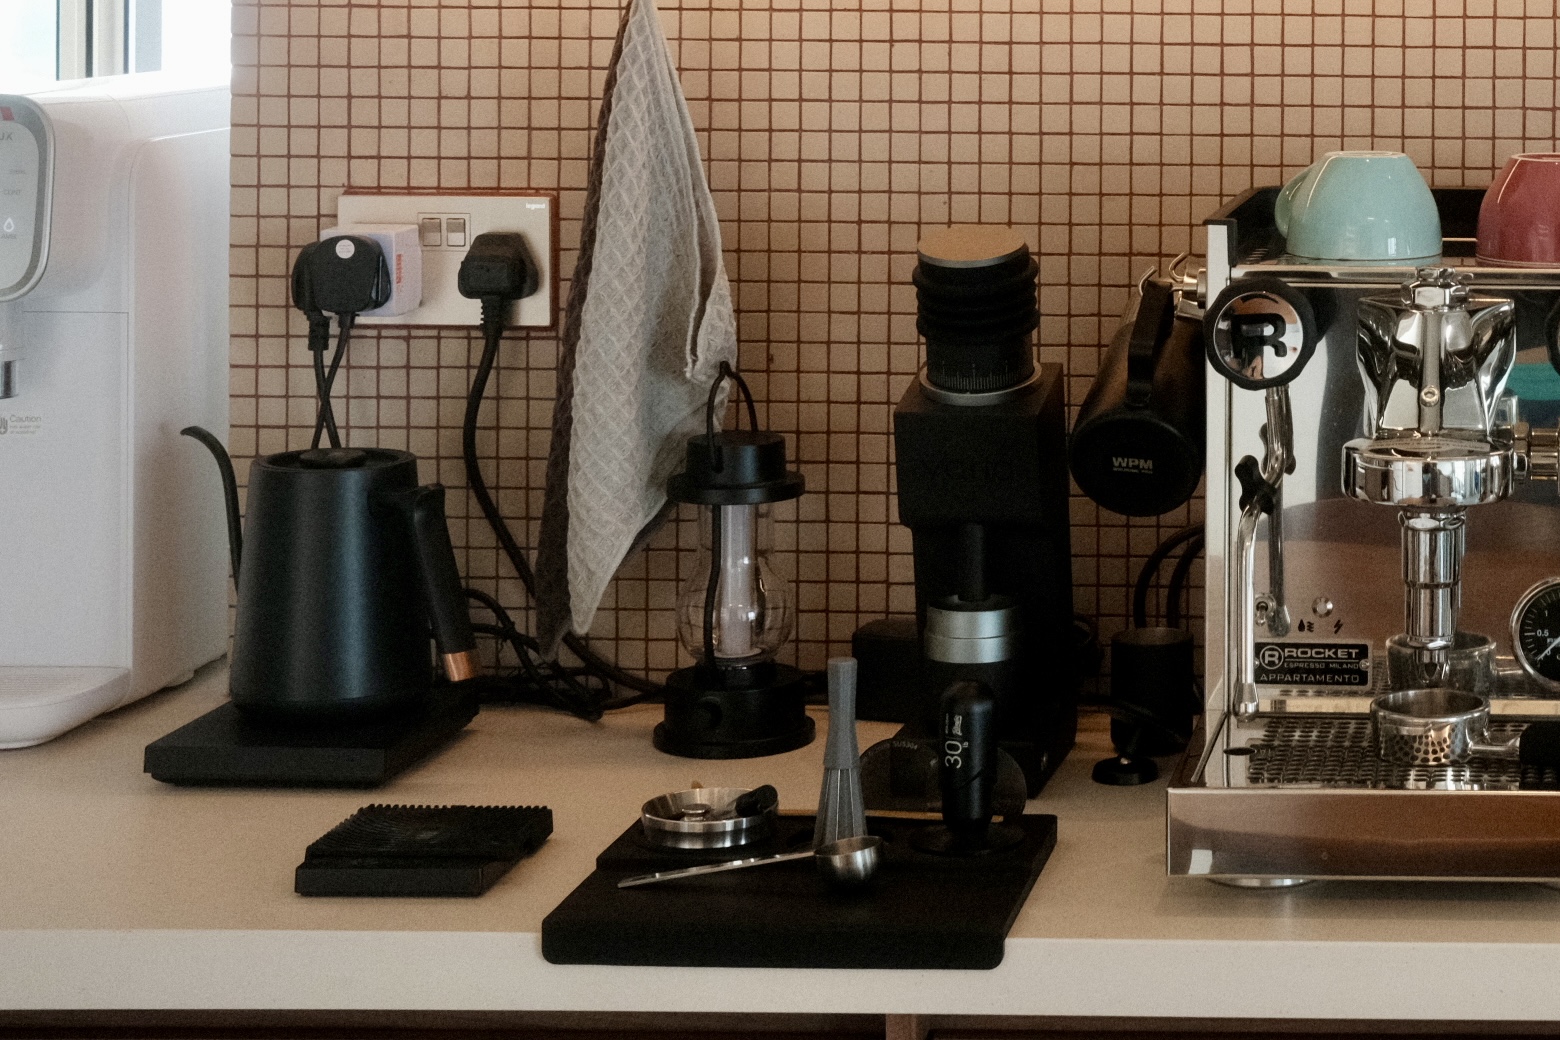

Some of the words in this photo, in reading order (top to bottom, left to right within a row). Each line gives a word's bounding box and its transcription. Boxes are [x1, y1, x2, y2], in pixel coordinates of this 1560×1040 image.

[1112, 456, 1153, 470] WPM
[1536, 629, 1549, 637] 0.5
[1264, 650, 1280, 664] R
[1284, 648, 1359, 659] ROCKET
[1260, 673, 1360, 683] APPARTAMENTO
[944, 740, 962, 769] 30
